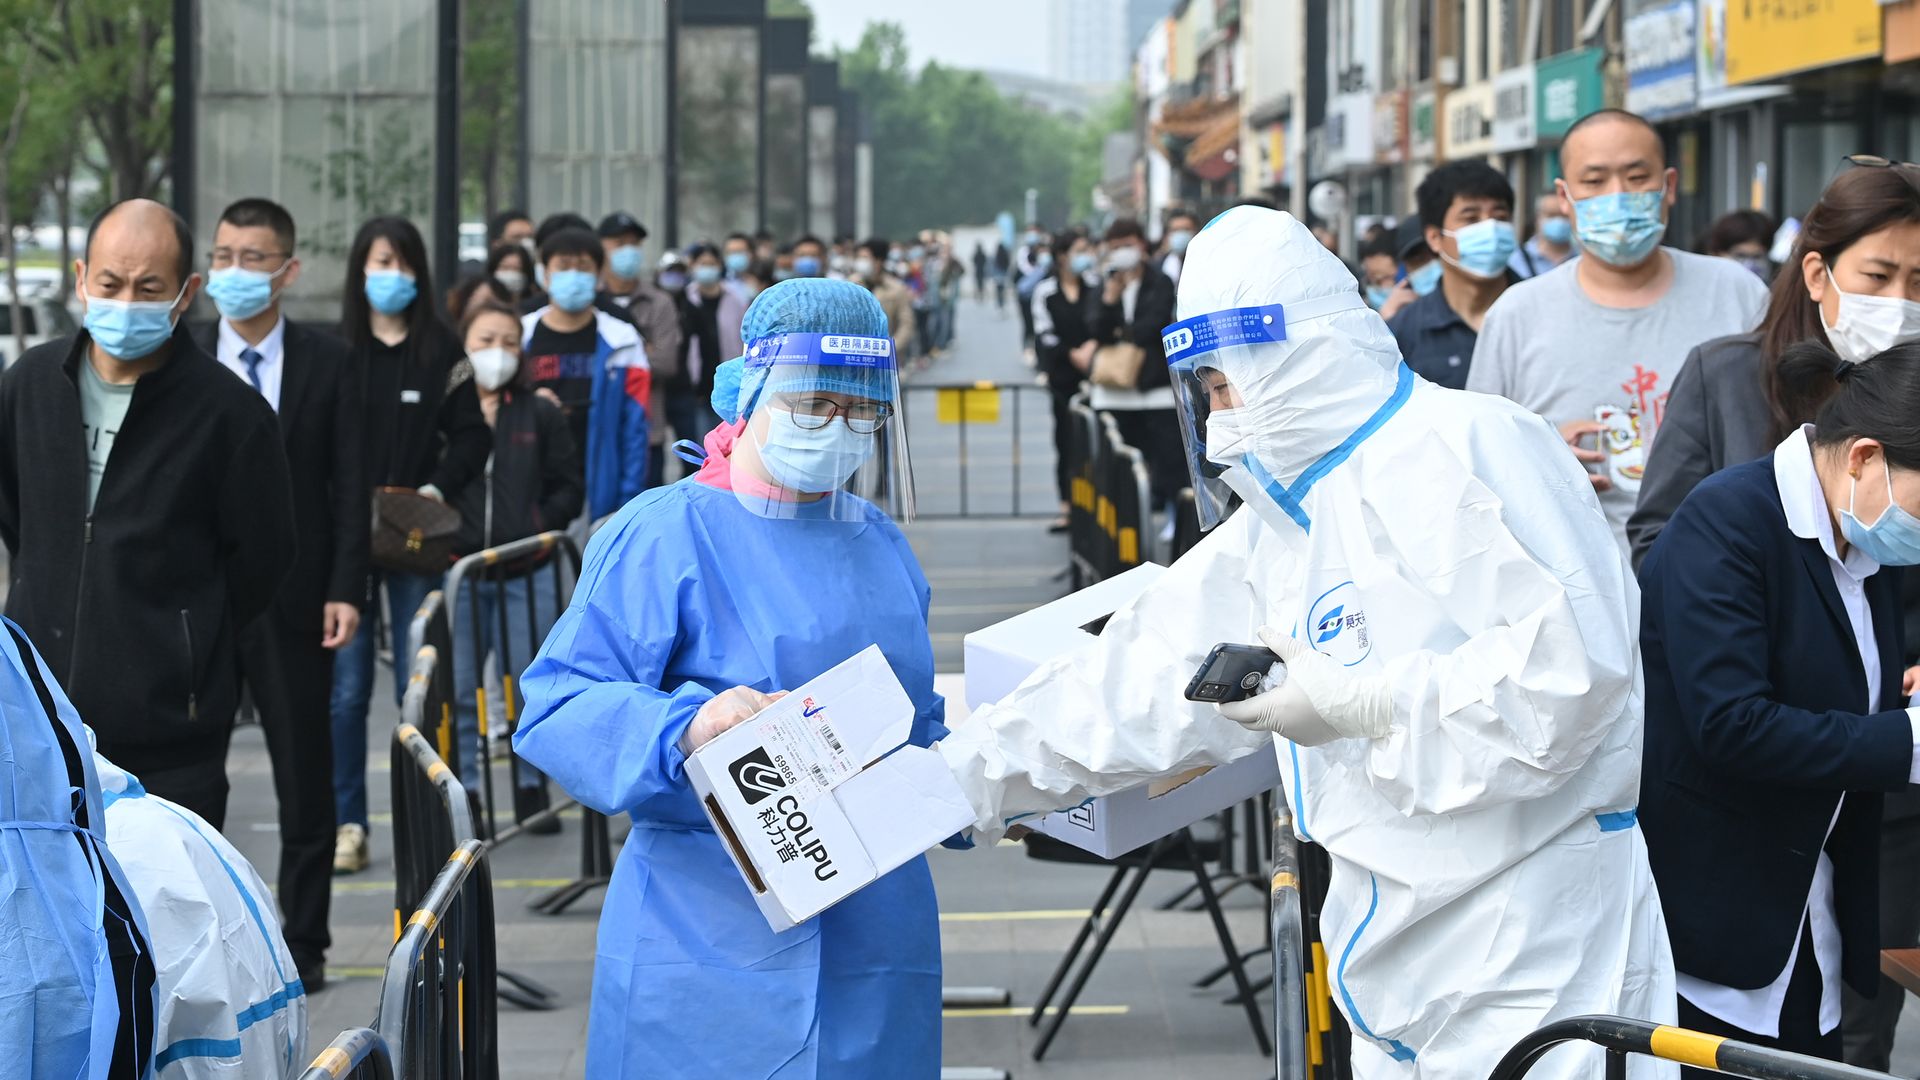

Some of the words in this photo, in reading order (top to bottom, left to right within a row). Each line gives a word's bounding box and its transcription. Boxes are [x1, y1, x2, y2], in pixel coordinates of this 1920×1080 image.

[829, 337, 887, 351] 医用隔离面罩
[774, 754, 797, 785] 69865
[756, 806, 800, 864] 科力普
[776, 795, 839, 882] COLIPU
